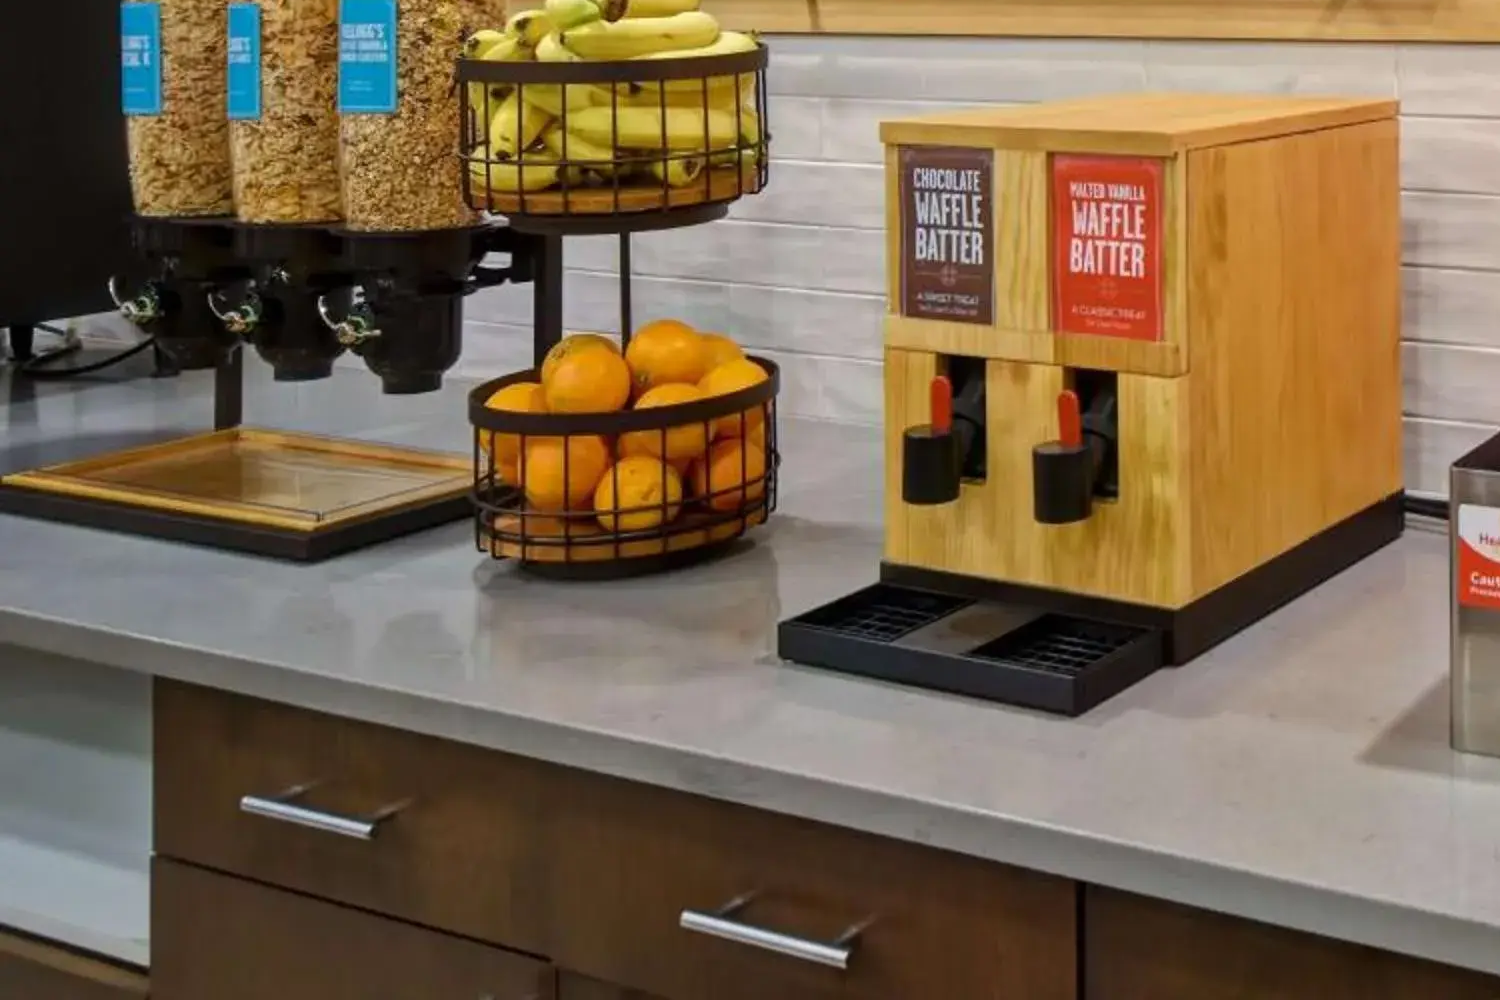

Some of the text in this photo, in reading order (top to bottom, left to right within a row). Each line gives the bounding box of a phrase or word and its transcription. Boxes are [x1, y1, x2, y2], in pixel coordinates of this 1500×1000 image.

[913, 167, 982, 193] CHOCOLATE
[914, 191, 985, 228] WAFFLE
[1071, 199, 1147, 240] WAFFLE
[915, 227, 984, 265] BATTER
[1069, 237, 1145, 278] BATTER
